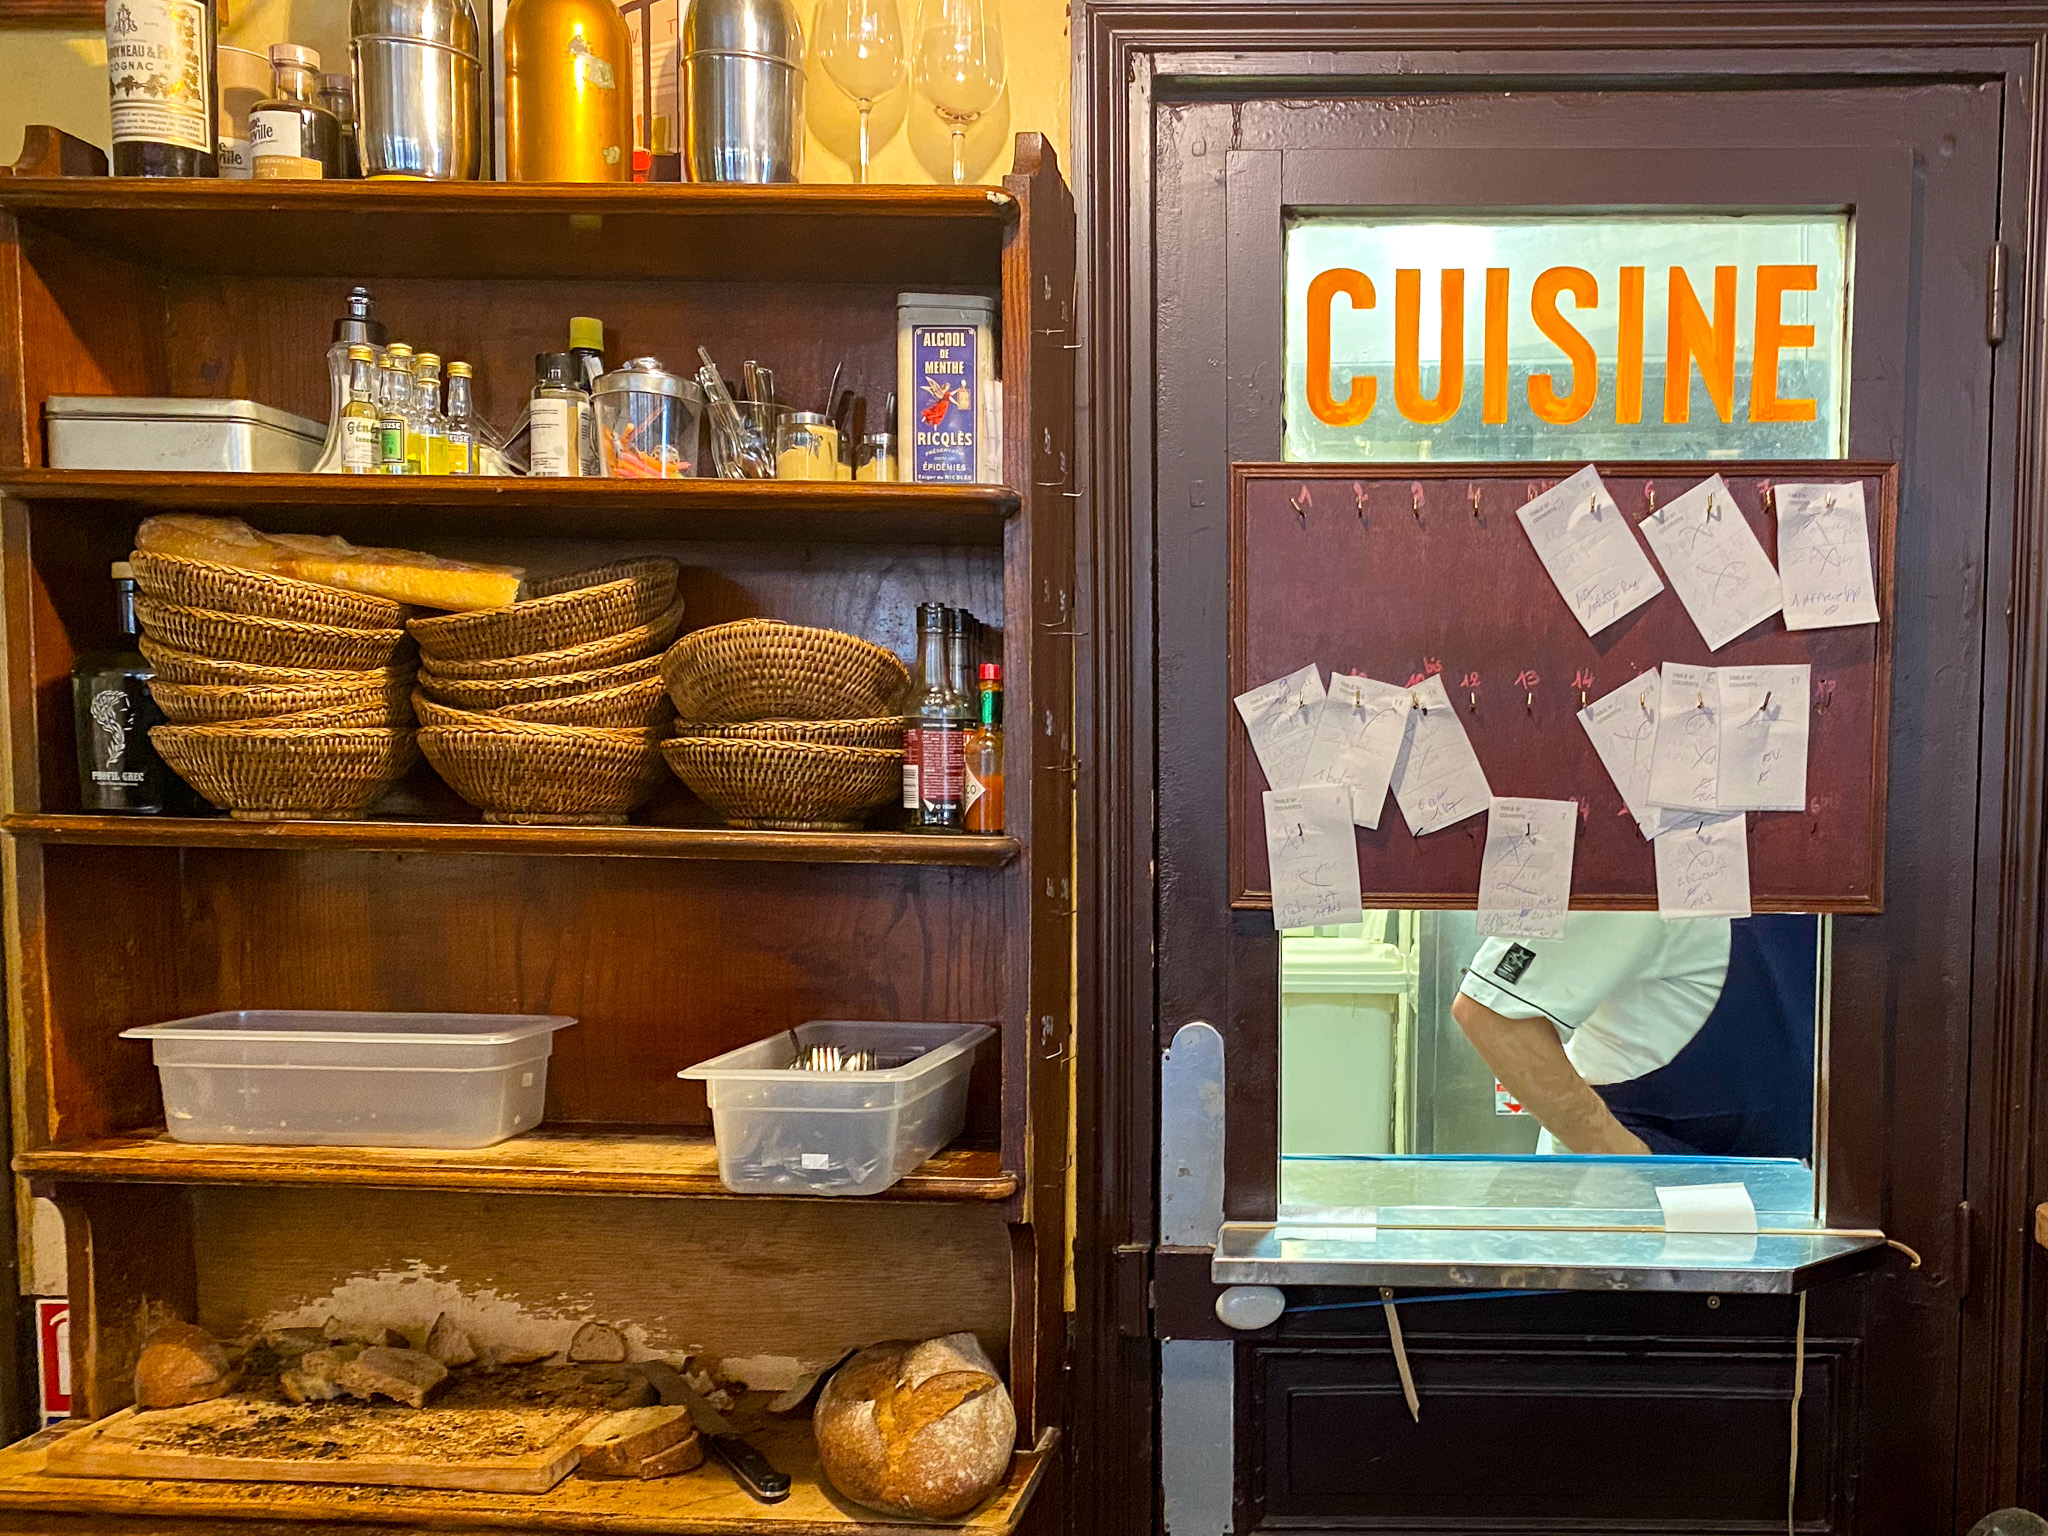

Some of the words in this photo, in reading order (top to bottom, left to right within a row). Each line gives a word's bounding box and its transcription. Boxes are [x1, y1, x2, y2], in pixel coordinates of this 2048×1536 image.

[923, 332, 966, 347] ALCOOL
[1306, 264, 1817, 427] CUISINE
[940, 349, 950, 359] DE
[925, 361, 965, 375] MENTHE
[917, 430, 973, 448] RICQLÈS
[922, 461, 967, 472] ÉPIDÉMIES
[1460, 671, 1481, 688] 12
[1514, 670, 1540, 690] 13
[1571, 667, 1596, 689] 14
